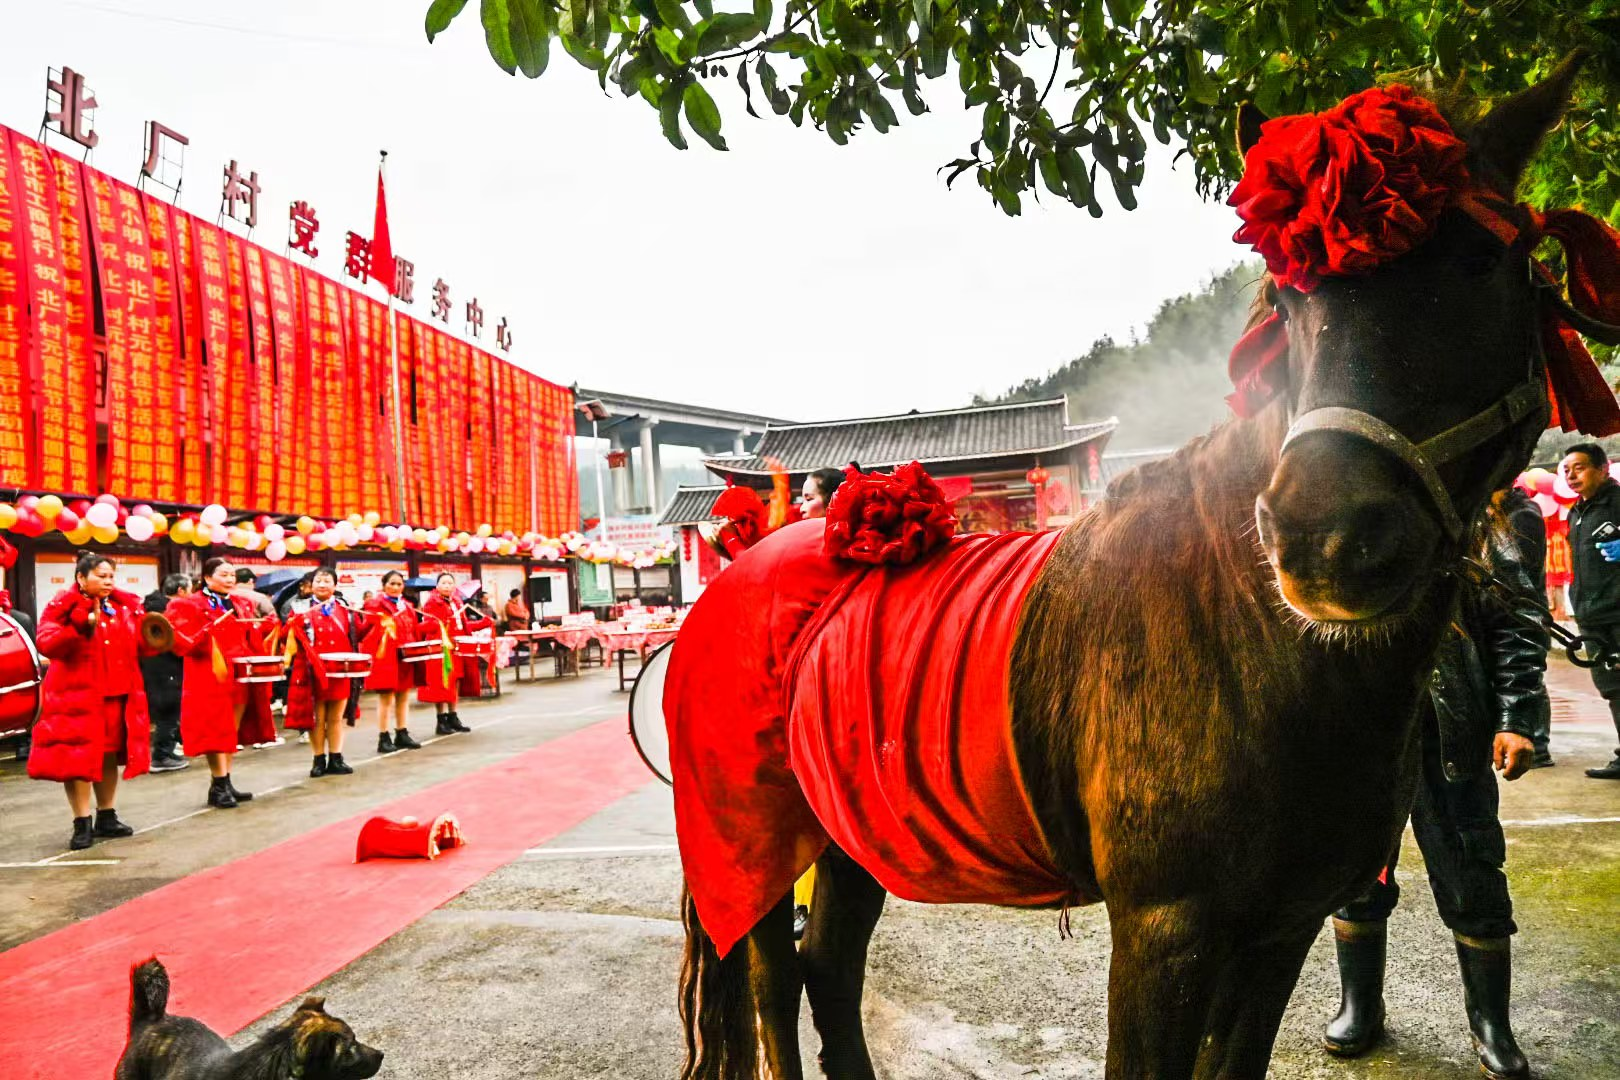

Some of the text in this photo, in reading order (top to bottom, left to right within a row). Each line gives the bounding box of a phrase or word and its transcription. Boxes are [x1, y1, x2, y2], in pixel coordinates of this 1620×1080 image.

[48, 66, 512, 352] 北厂村党群服务中心
